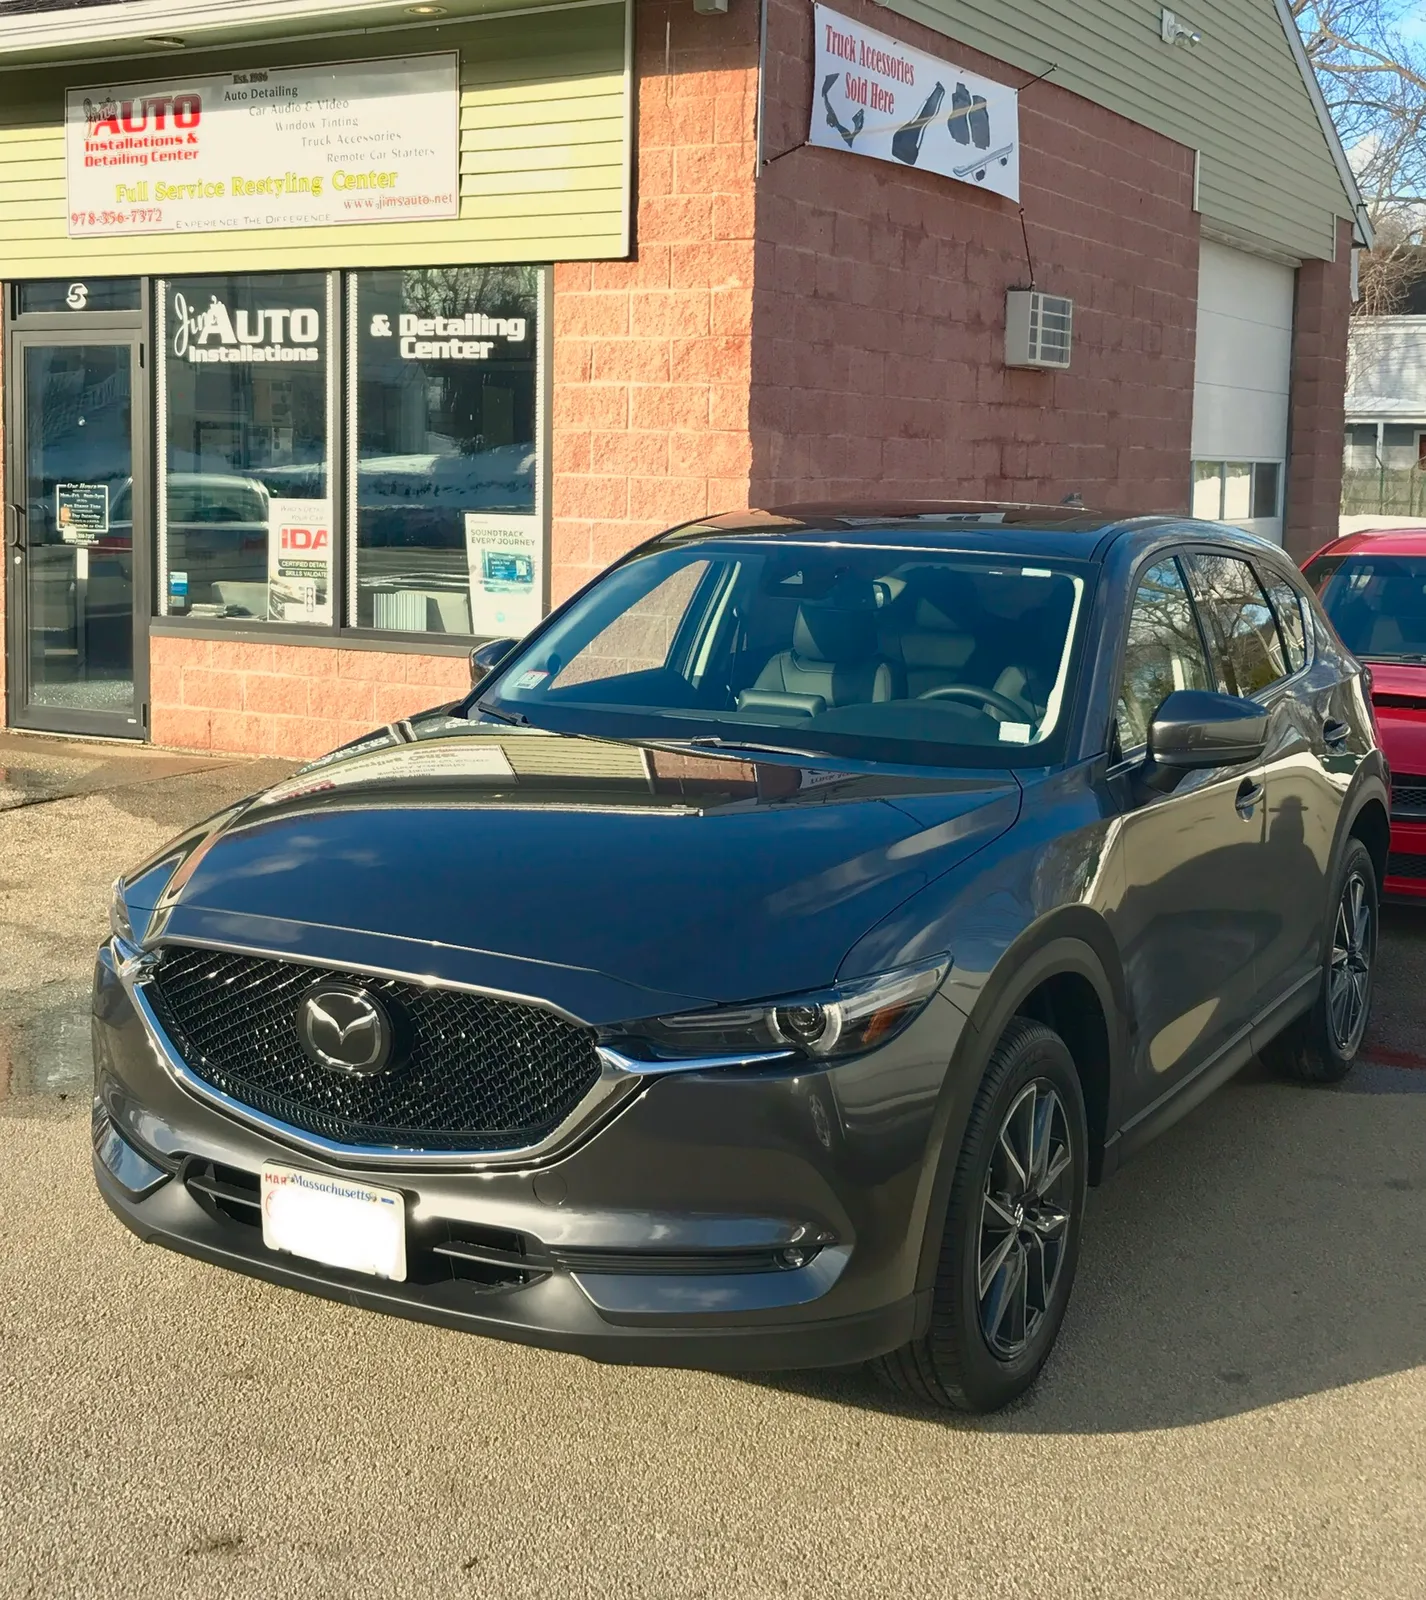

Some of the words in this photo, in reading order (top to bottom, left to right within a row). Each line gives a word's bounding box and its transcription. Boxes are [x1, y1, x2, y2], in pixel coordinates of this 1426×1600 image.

[826, 24, 856, 63] Truck
[859, 40, 914, 86] Accessories
[224, 91, 247, 101] Auto
[250, 85, 298, 98] Detailing
[845, 72, 867, 105] Sold
[870, 82, 894, 114] Here
[93, 93, 202, 136] AUTO
[249, 105, 266, 116] Car
[270, 102, 301, 114] Audio
[305, 101, 313, 111] &
[317, 98, 349, 110] Video
[275, 120, 315, 132] Window
[321, 117, 359, 129] Tinting
[85, 135, 183, 152] Installations
[187, 133, 198, 144] &
[301, 135, 331, 147] Truck
[337, 131, 402, 144] Accessories
[84, 153, 148, 167] Detailing
[151, 150, 199, 162] Center
[327, 151, 365, 163] Remote
[370, 150, 387, 160] Car
[392, 148, 435, 159] Starters
[116, 181, 149, 203] Full
[155, 178, 225, 201] Service
[231, 172, 324, 198] Restyling
[332, 168, 398, 191] Center
[343, 194, 453, 210] www.jimsauto.net
[71, 208, 163, 226] 978-356-7372
[244, 216, 261, 225] THE
[67, 283, 86, 307] 5
[174, 292, 219, 356] Jim'
[197, 301, 319, 344] AUTO
[370, 314, 392, 336] &
[399, 313, 526, 341] Detailing
[189, 345, 319, 362] Installations
[400, 337, 493, 359] Center
[471, 529, 524, 538] SOUNDTRACK
[497, 538, 535, 546] JOURNEY
[281, 560, 308, 568] CERTIFIED
[293, 1173, 371, 1201] Massachusetts
